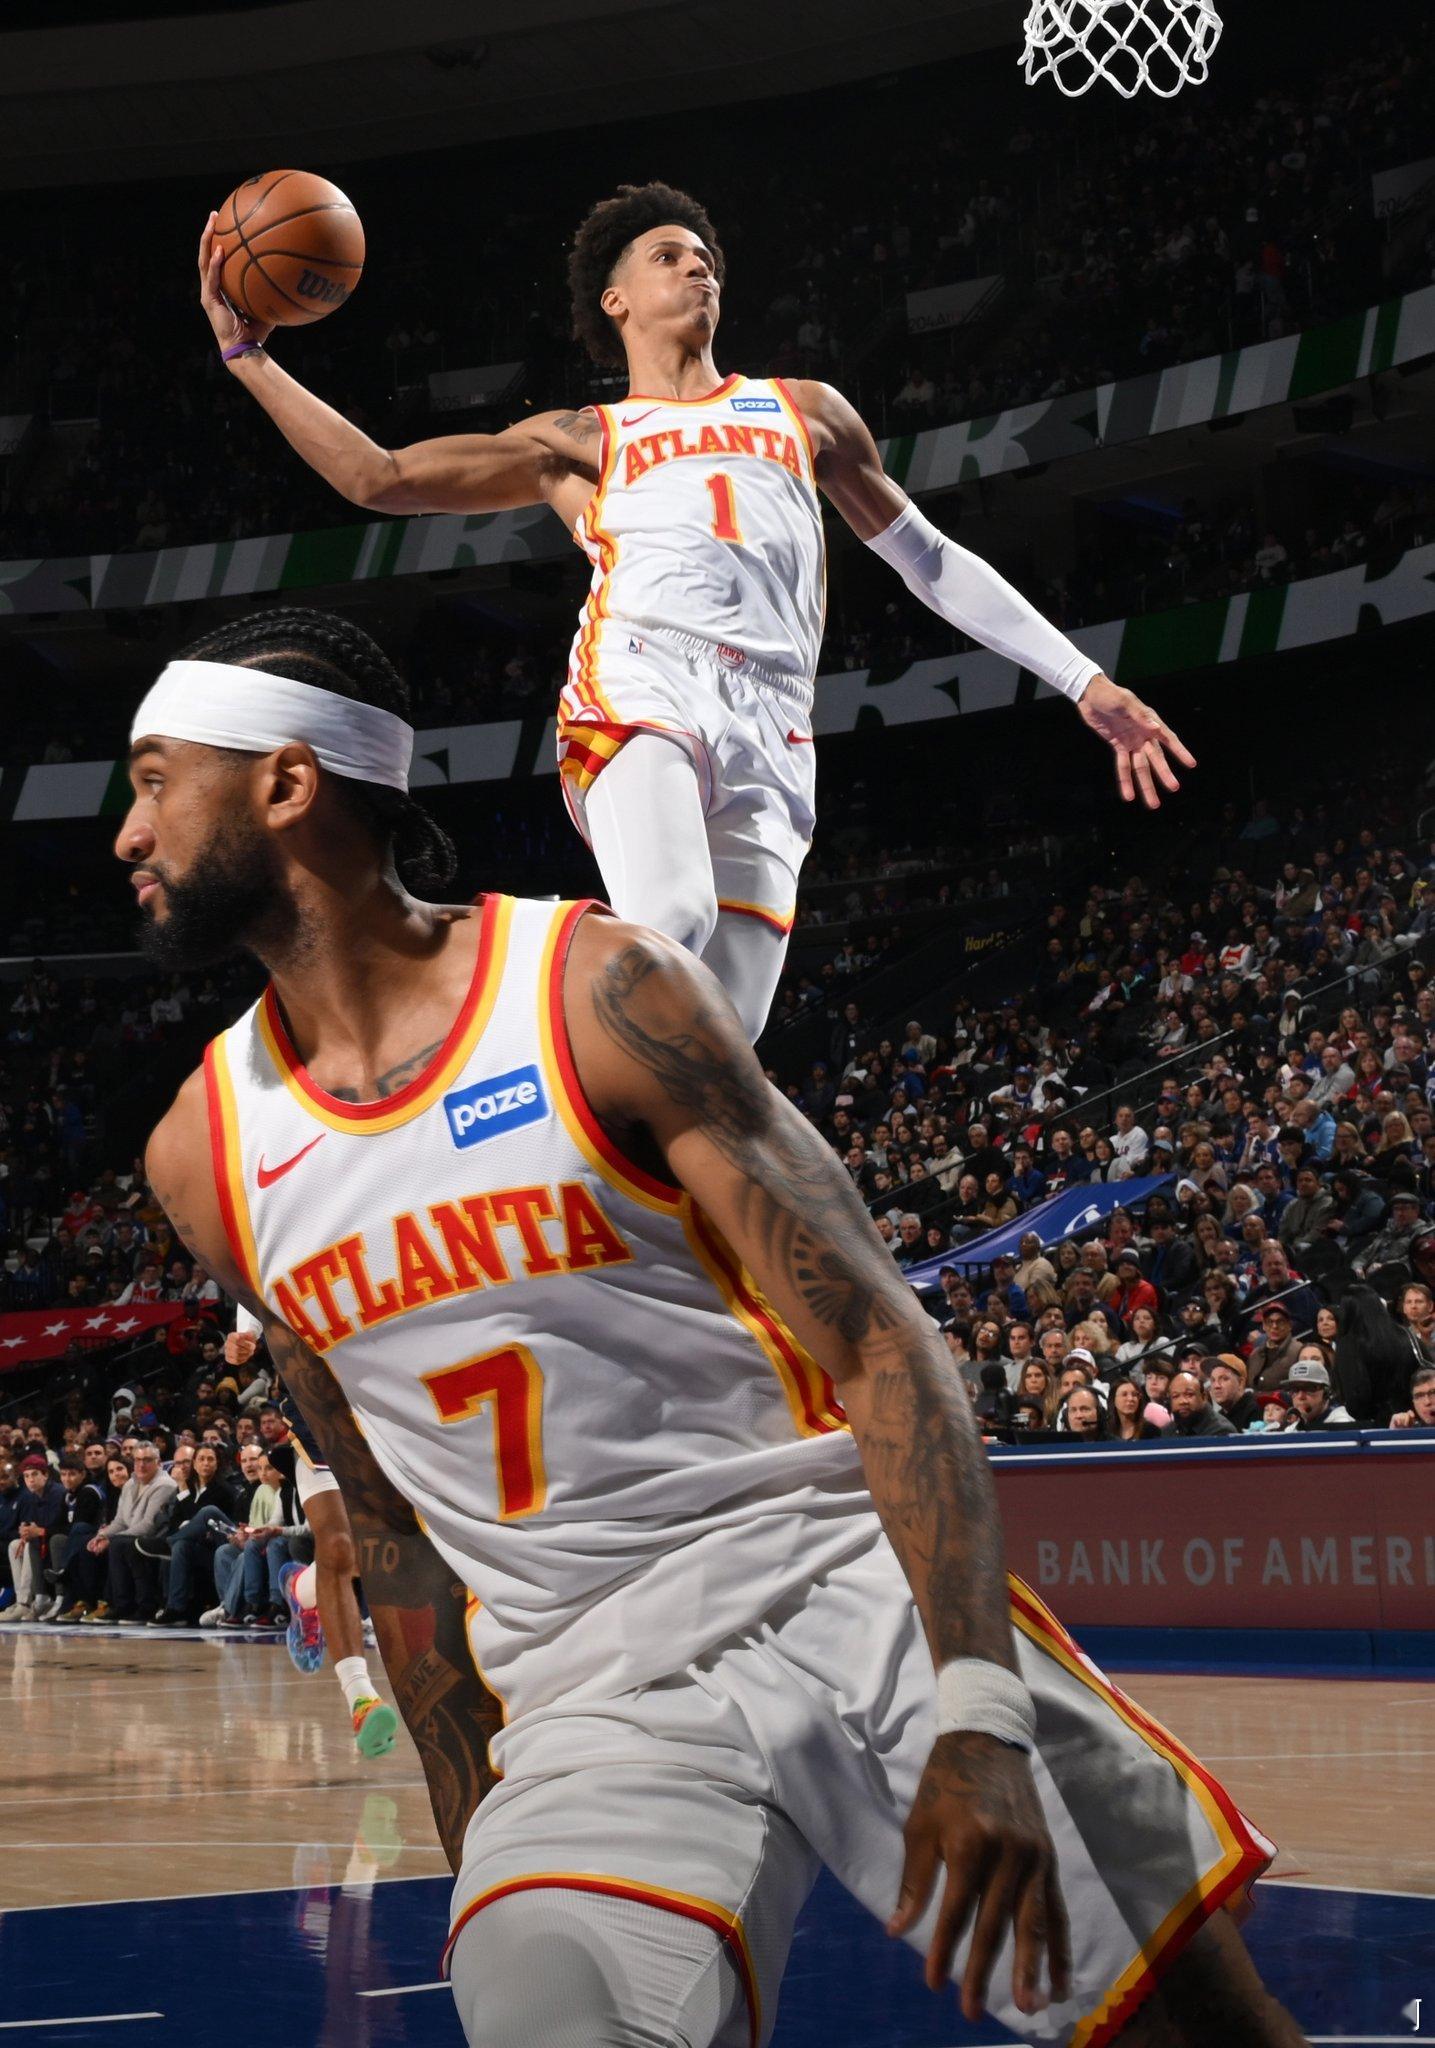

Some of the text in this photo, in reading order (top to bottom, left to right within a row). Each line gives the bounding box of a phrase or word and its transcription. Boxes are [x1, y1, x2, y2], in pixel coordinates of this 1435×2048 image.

[733, 400, 777, 411] paze
[625, 424, 803, 489] ATLANTA
[704, 471, 744, 545] 1
[716, 642, 747, 664] HAWKS
[452, 1081, 538, 1136] paze
[271, 1181, 635, 1357] ATLANTA
[419, 1341, 548, 1522] 7
[1037, 1539, 1167, 1586] BANK
[1182, 1538, 1245, 1587] OF
